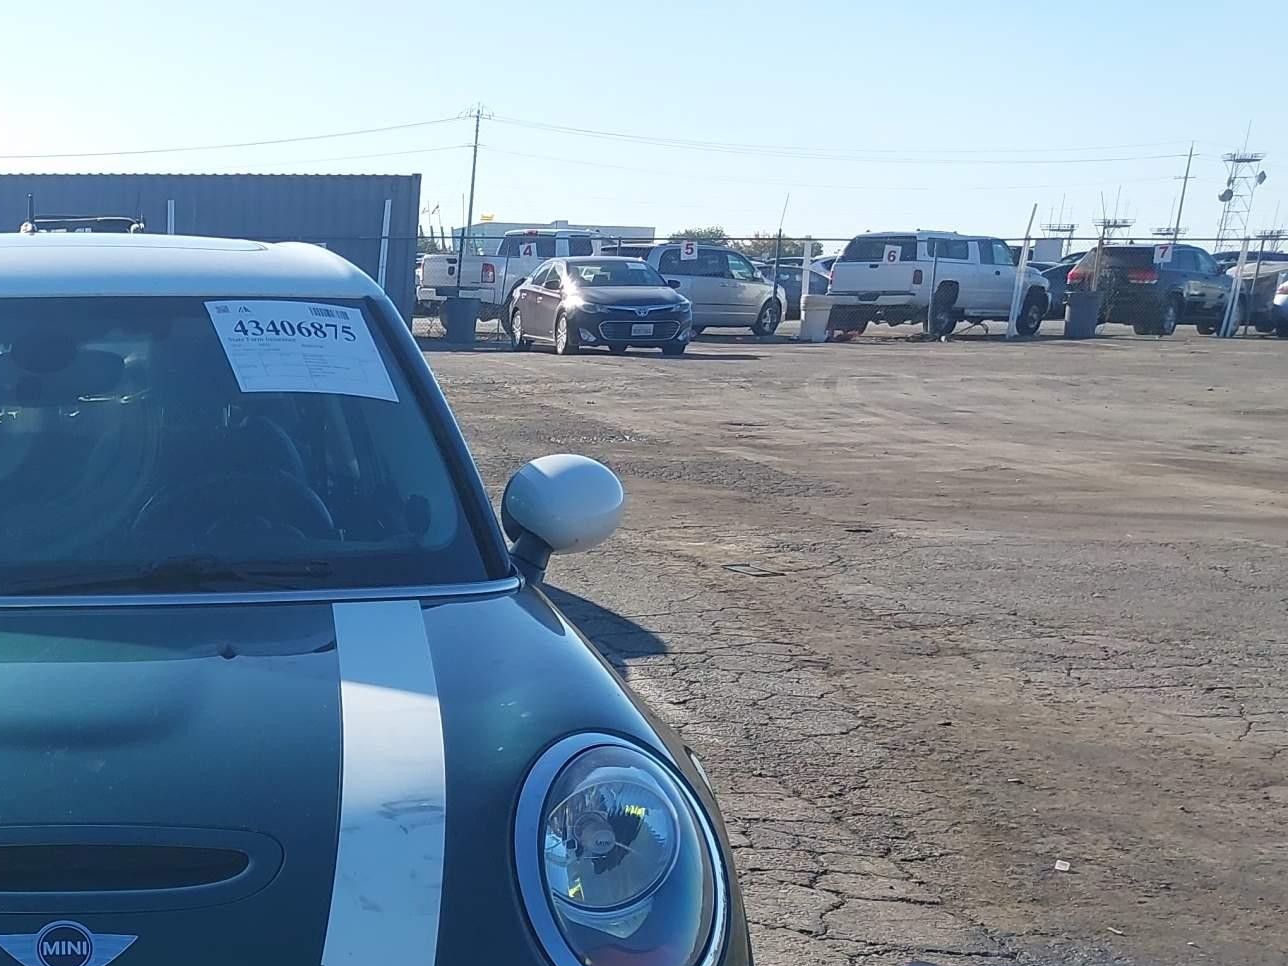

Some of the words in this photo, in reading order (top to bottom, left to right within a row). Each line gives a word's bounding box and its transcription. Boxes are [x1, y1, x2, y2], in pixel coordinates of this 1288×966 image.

[522, 244, 533, 257] 4
[684, 242, 695, 256] 5
[887, 249, 897, 263] 6
[1159, 245, 1170, 259] 7
[233, 319, 357, 342] 43406875
[43, 940, 88, 956] MINI
